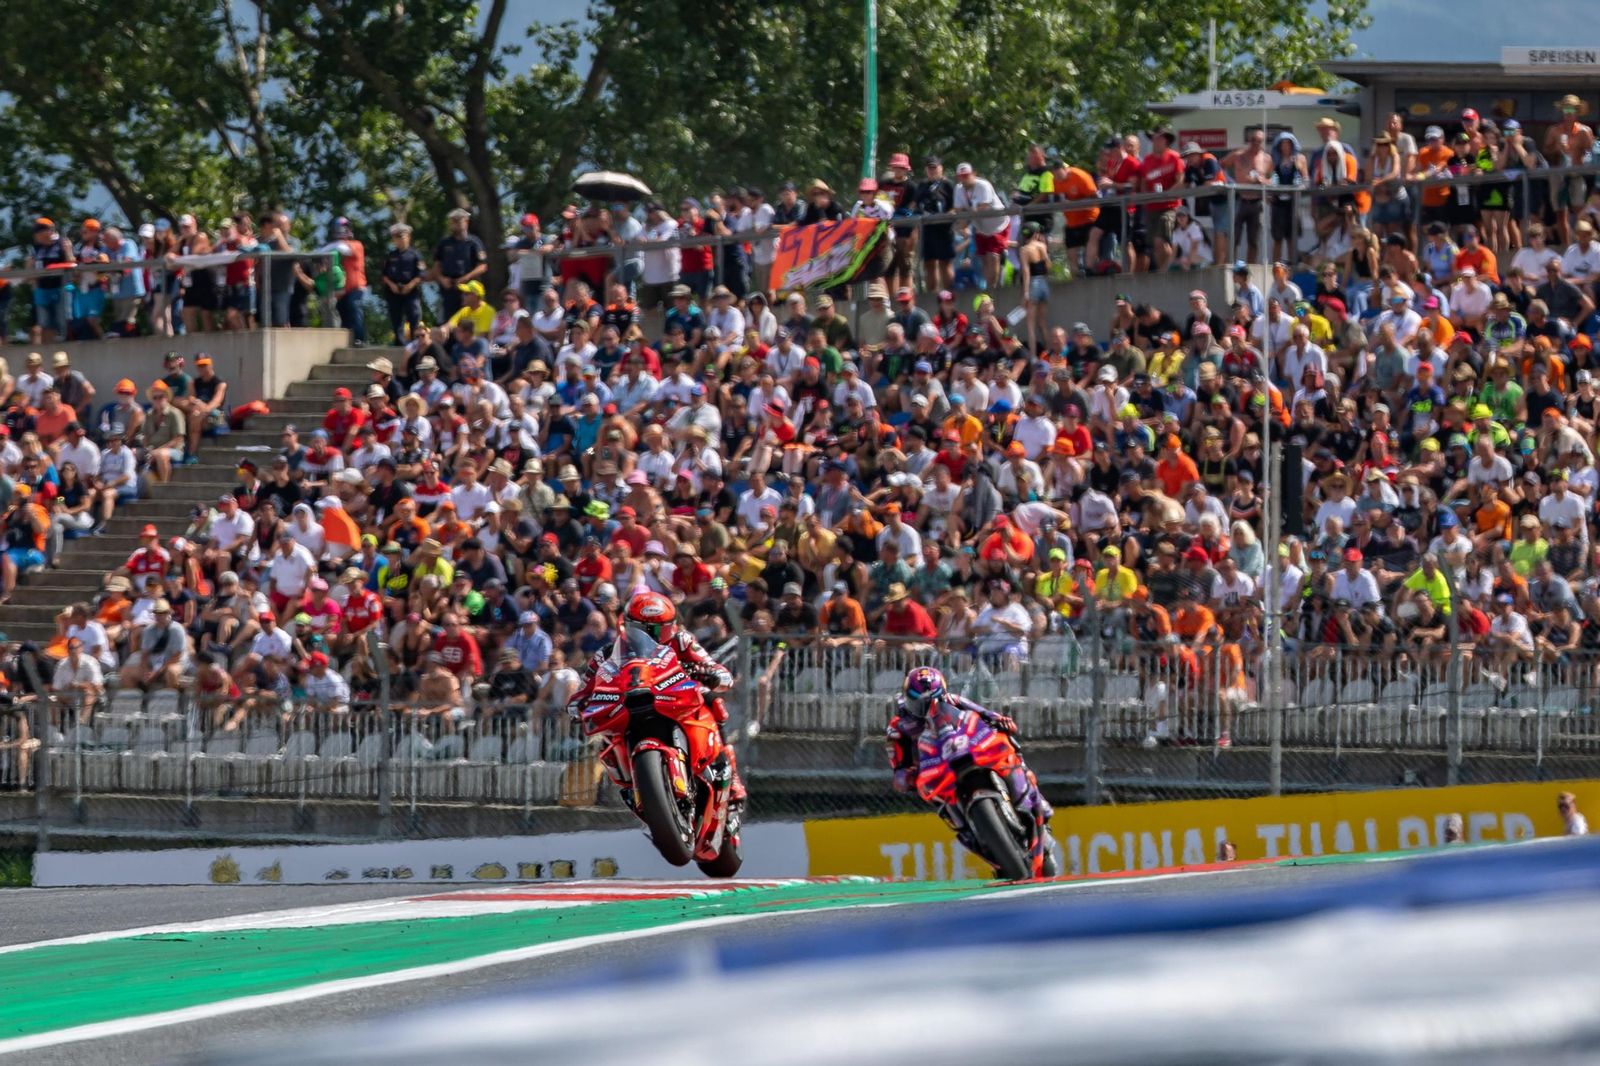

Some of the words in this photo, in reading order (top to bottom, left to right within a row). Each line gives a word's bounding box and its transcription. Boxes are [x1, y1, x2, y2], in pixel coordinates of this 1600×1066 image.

[1528, 49, 1597, 64] SPEISEN
[1213, 93, 1266, 107] KASSA
[629, 667, 641, 687] 1
[655, 672, 685, 692] Lenovo
[592, 693, 620, 701] Lenovo
